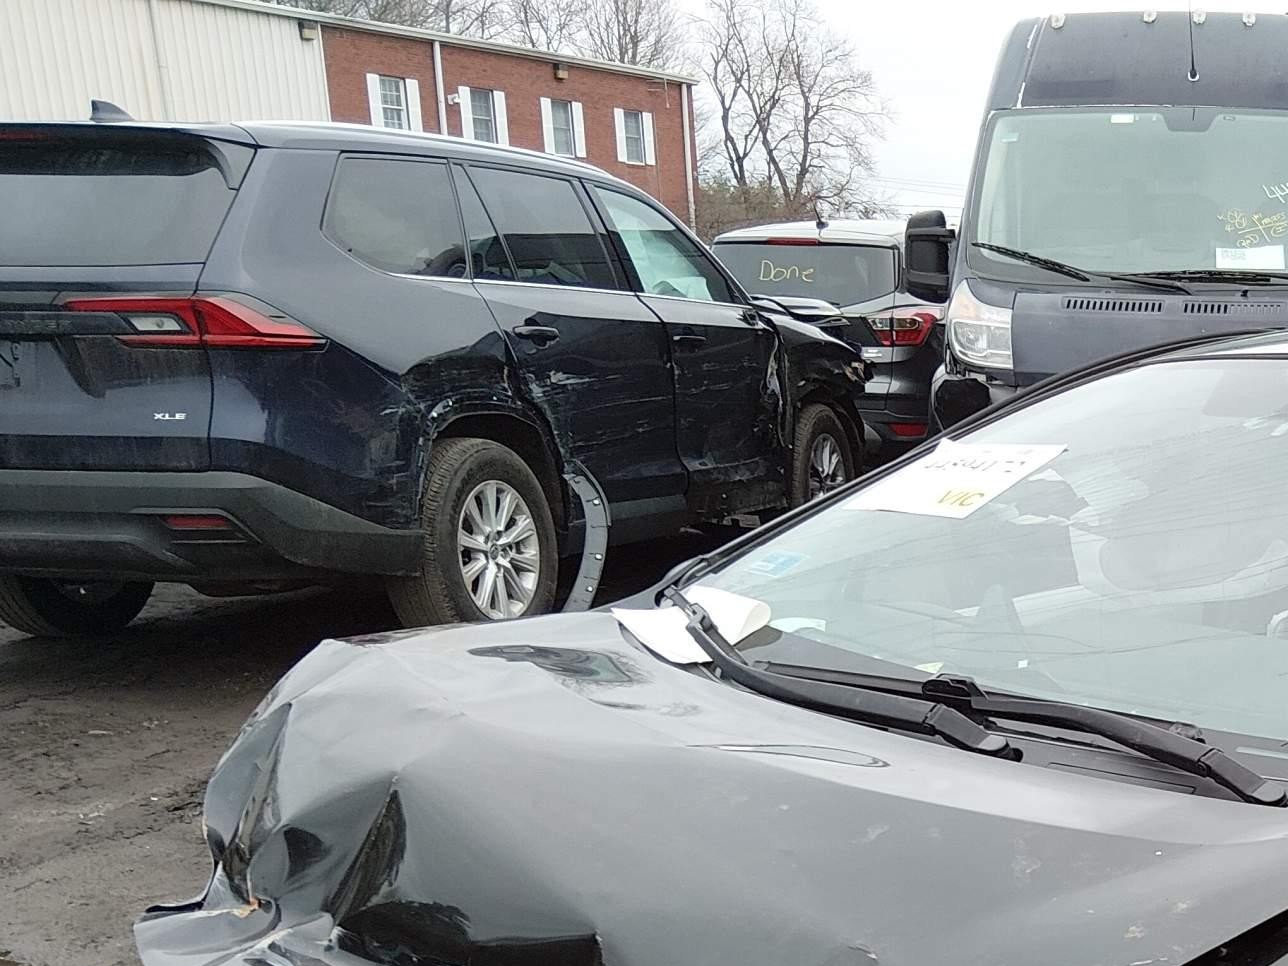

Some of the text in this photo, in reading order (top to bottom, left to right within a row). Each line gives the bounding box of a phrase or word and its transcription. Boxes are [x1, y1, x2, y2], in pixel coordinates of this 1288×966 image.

[759, 259, 815, 283] Done
[153, 412, 187, 420] XLE
[937, 488, 985, 508] VIC
